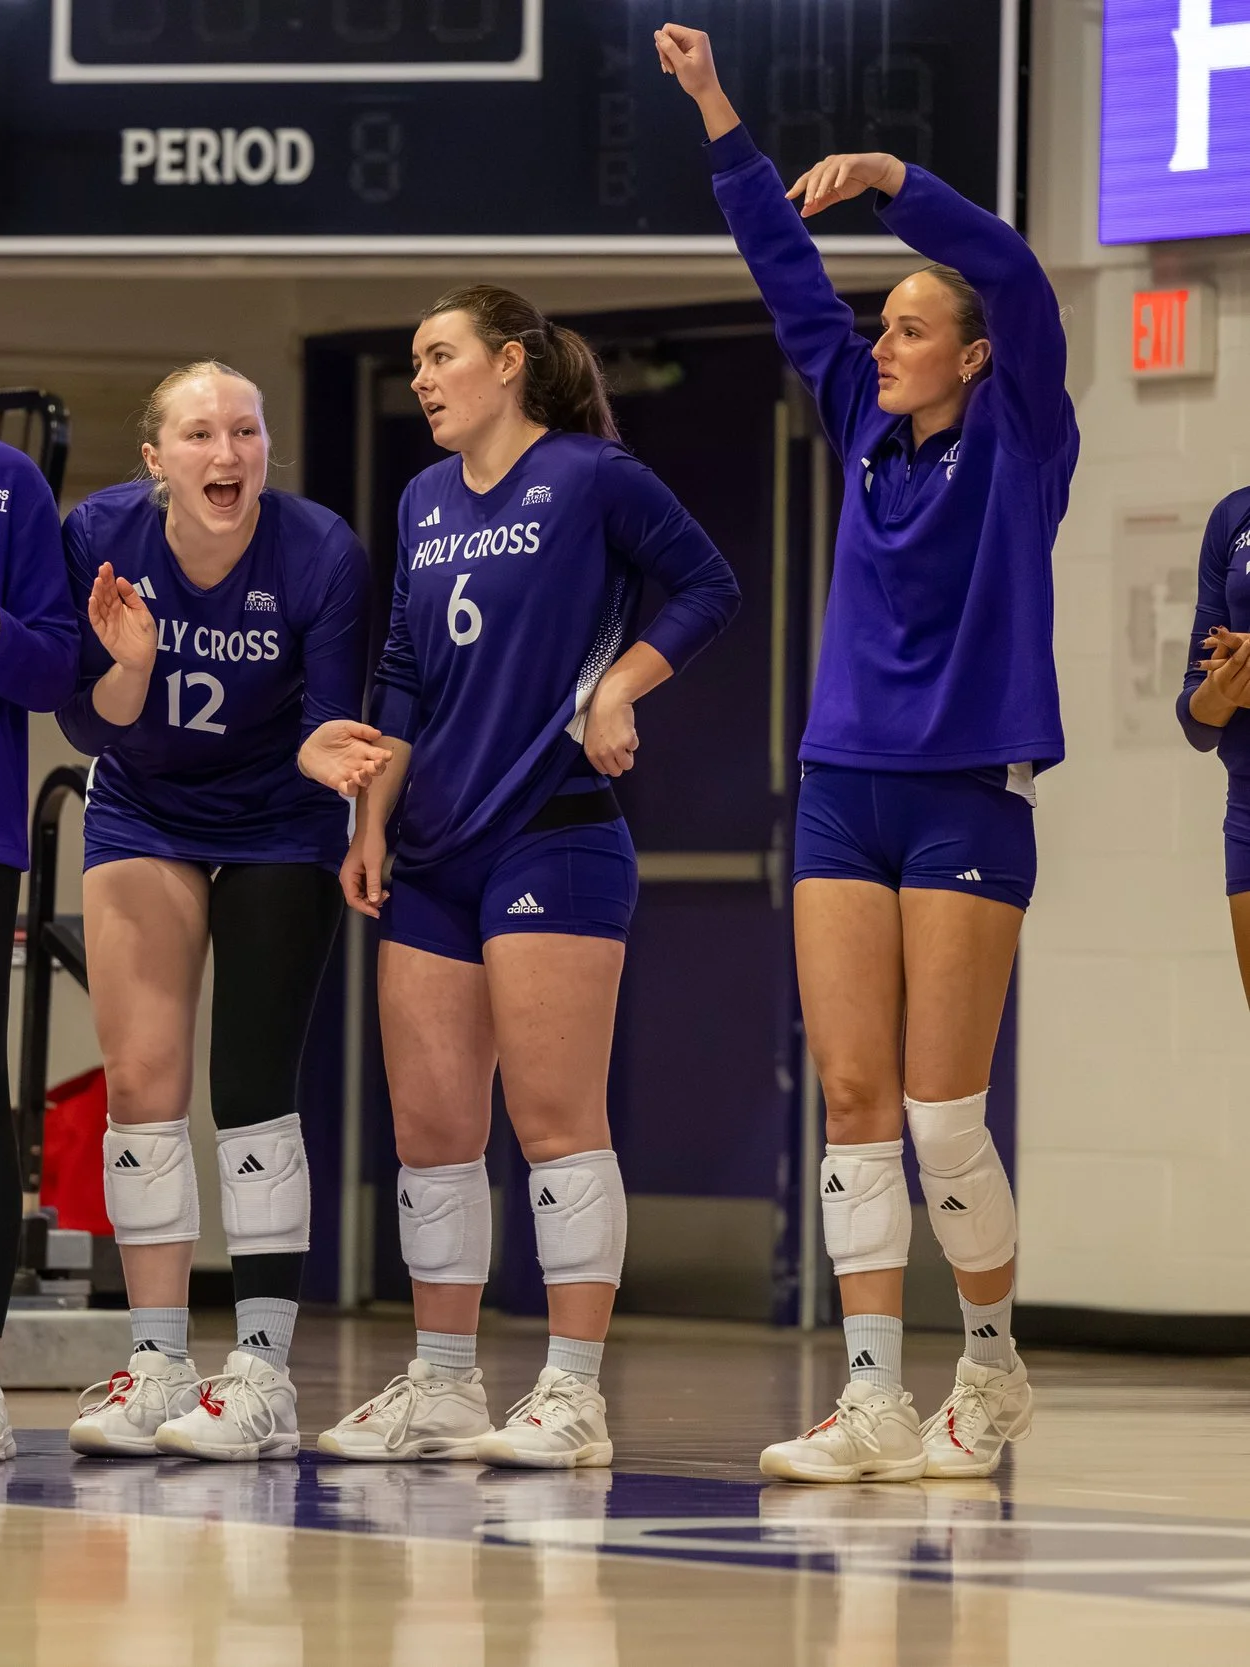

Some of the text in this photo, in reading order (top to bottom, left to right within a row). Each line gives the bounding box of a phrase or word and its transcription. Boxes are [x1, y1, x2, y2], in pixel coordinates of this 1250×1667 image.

[120, 127, 314, 185] PERIOD
[1133, 290, 1189, 370] EXIT
[411, 521, 541, 570] HOLY CROSS
[447, 573, 483, 646] 6
[156, 618, 280, 662] LY CROSS
[165, 669, 227, 735] 12
[507, 906, 544, 914] adidas
